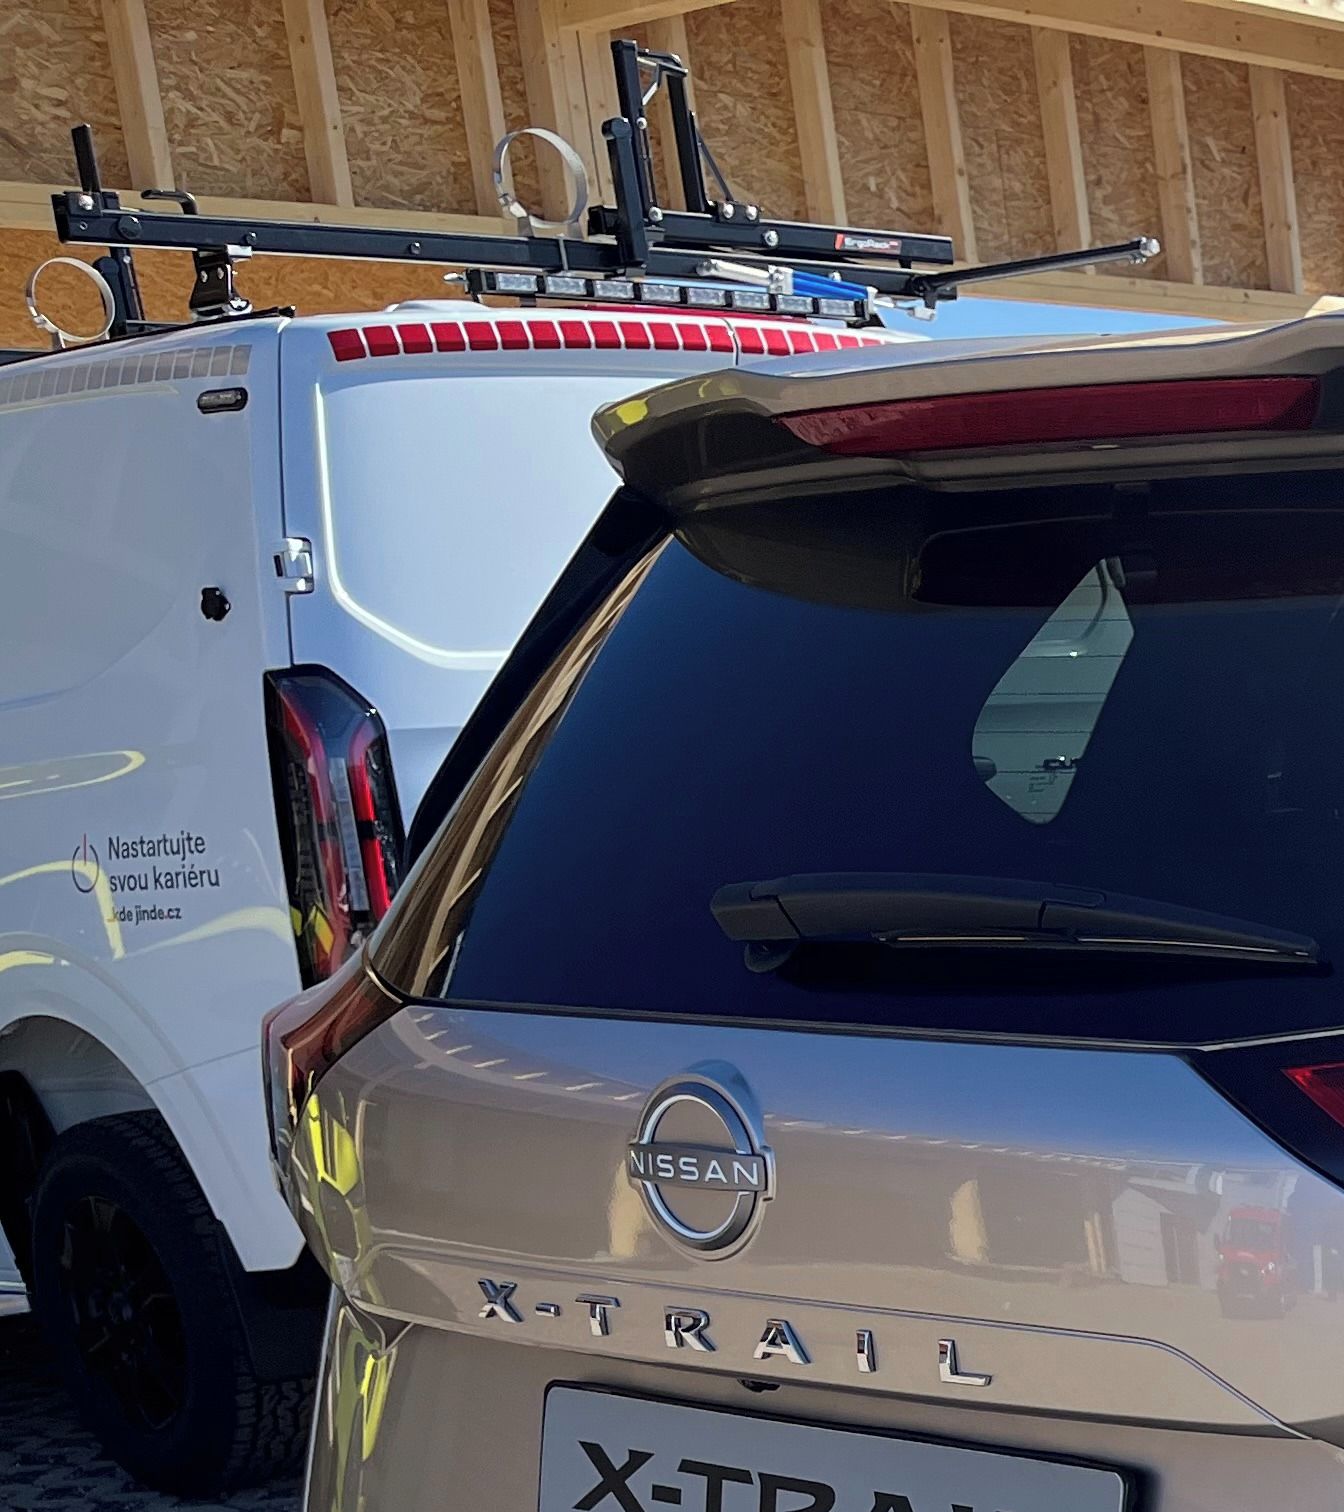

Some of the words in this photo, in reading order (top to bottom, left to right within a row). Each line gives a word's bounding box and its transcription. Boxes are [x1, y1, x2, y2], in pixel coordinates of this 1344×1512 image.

[108, 830, 206, 861] Nastartujte
[110, 873, 148, 892] svou
[153, 864, 220, 890] kariéru
[630, 1150, 759, 1186] NISSAN
[478, 1278, 993, 1386] X-TRAIL
